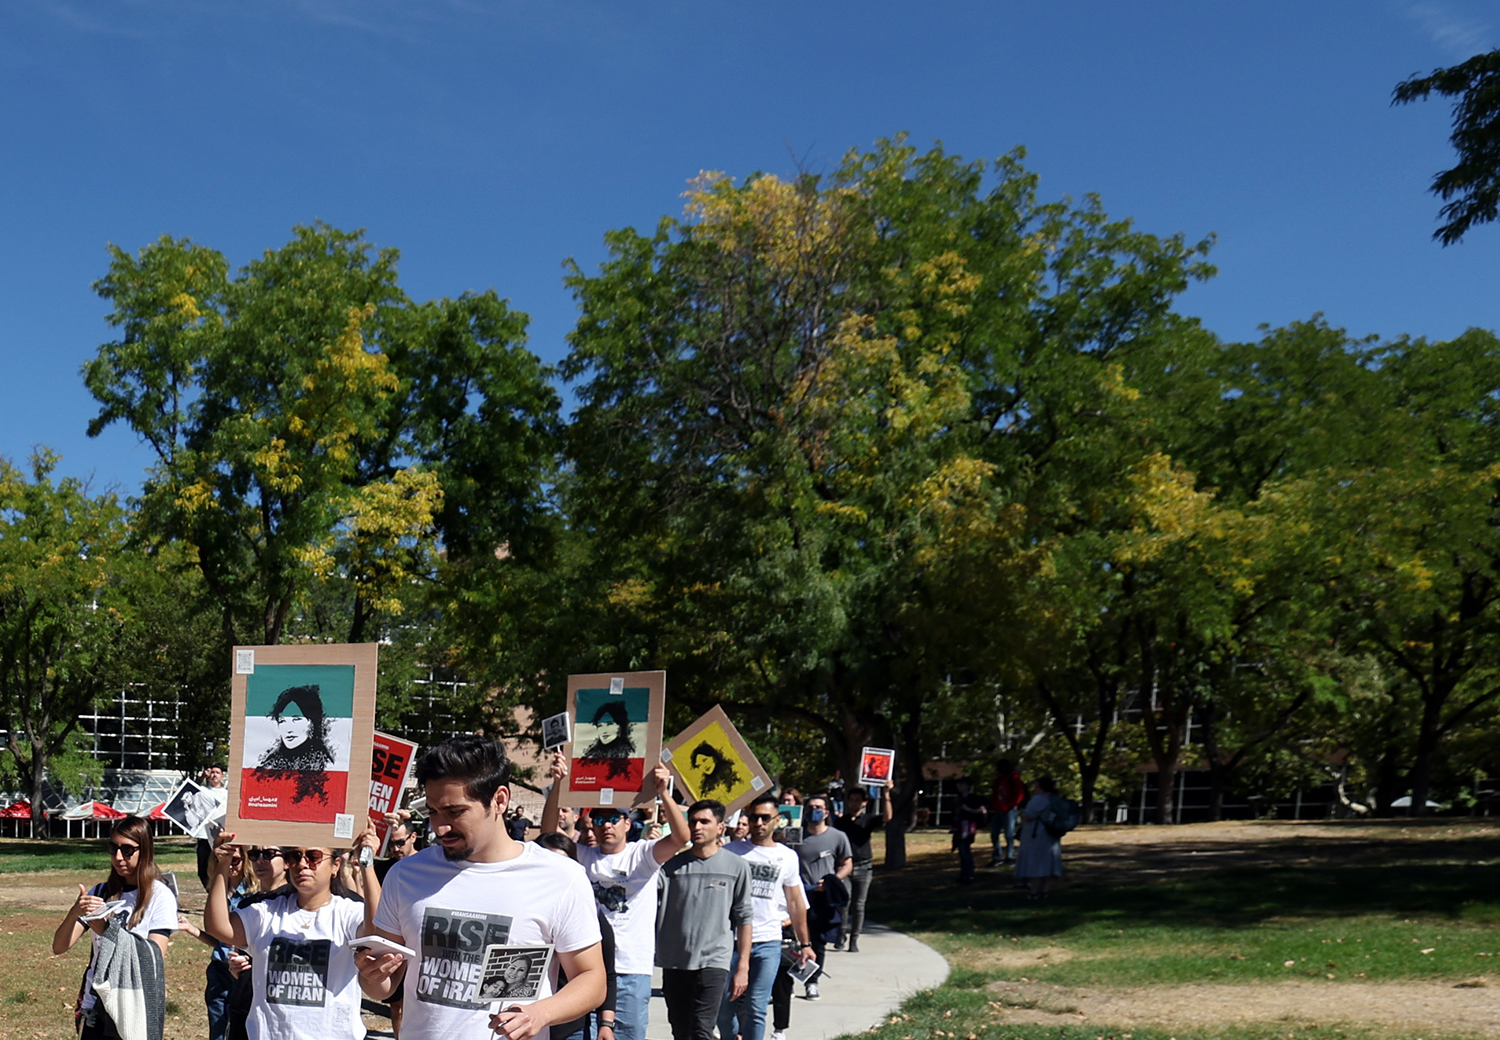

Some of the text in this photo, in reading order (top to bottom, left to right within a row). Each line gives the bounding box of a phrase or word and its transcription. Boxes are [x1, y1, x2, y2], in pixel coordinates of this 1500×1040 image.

[372, 749, 404, 779] SE
[369, 796, 390, 814] AN
[752, 879, 777, 892] OMEN
[424, 916, 509, 954] RISE
[269, 941, 328, 966] RISE
[463, 953, 481, 963] THE
[268, 970, 324, 987] WOMEN
[423, 956, 483, 983] WOME
[268, 985, 323, 1001] OF IRAN
[419, 975, 478, 1003] OF IRA
